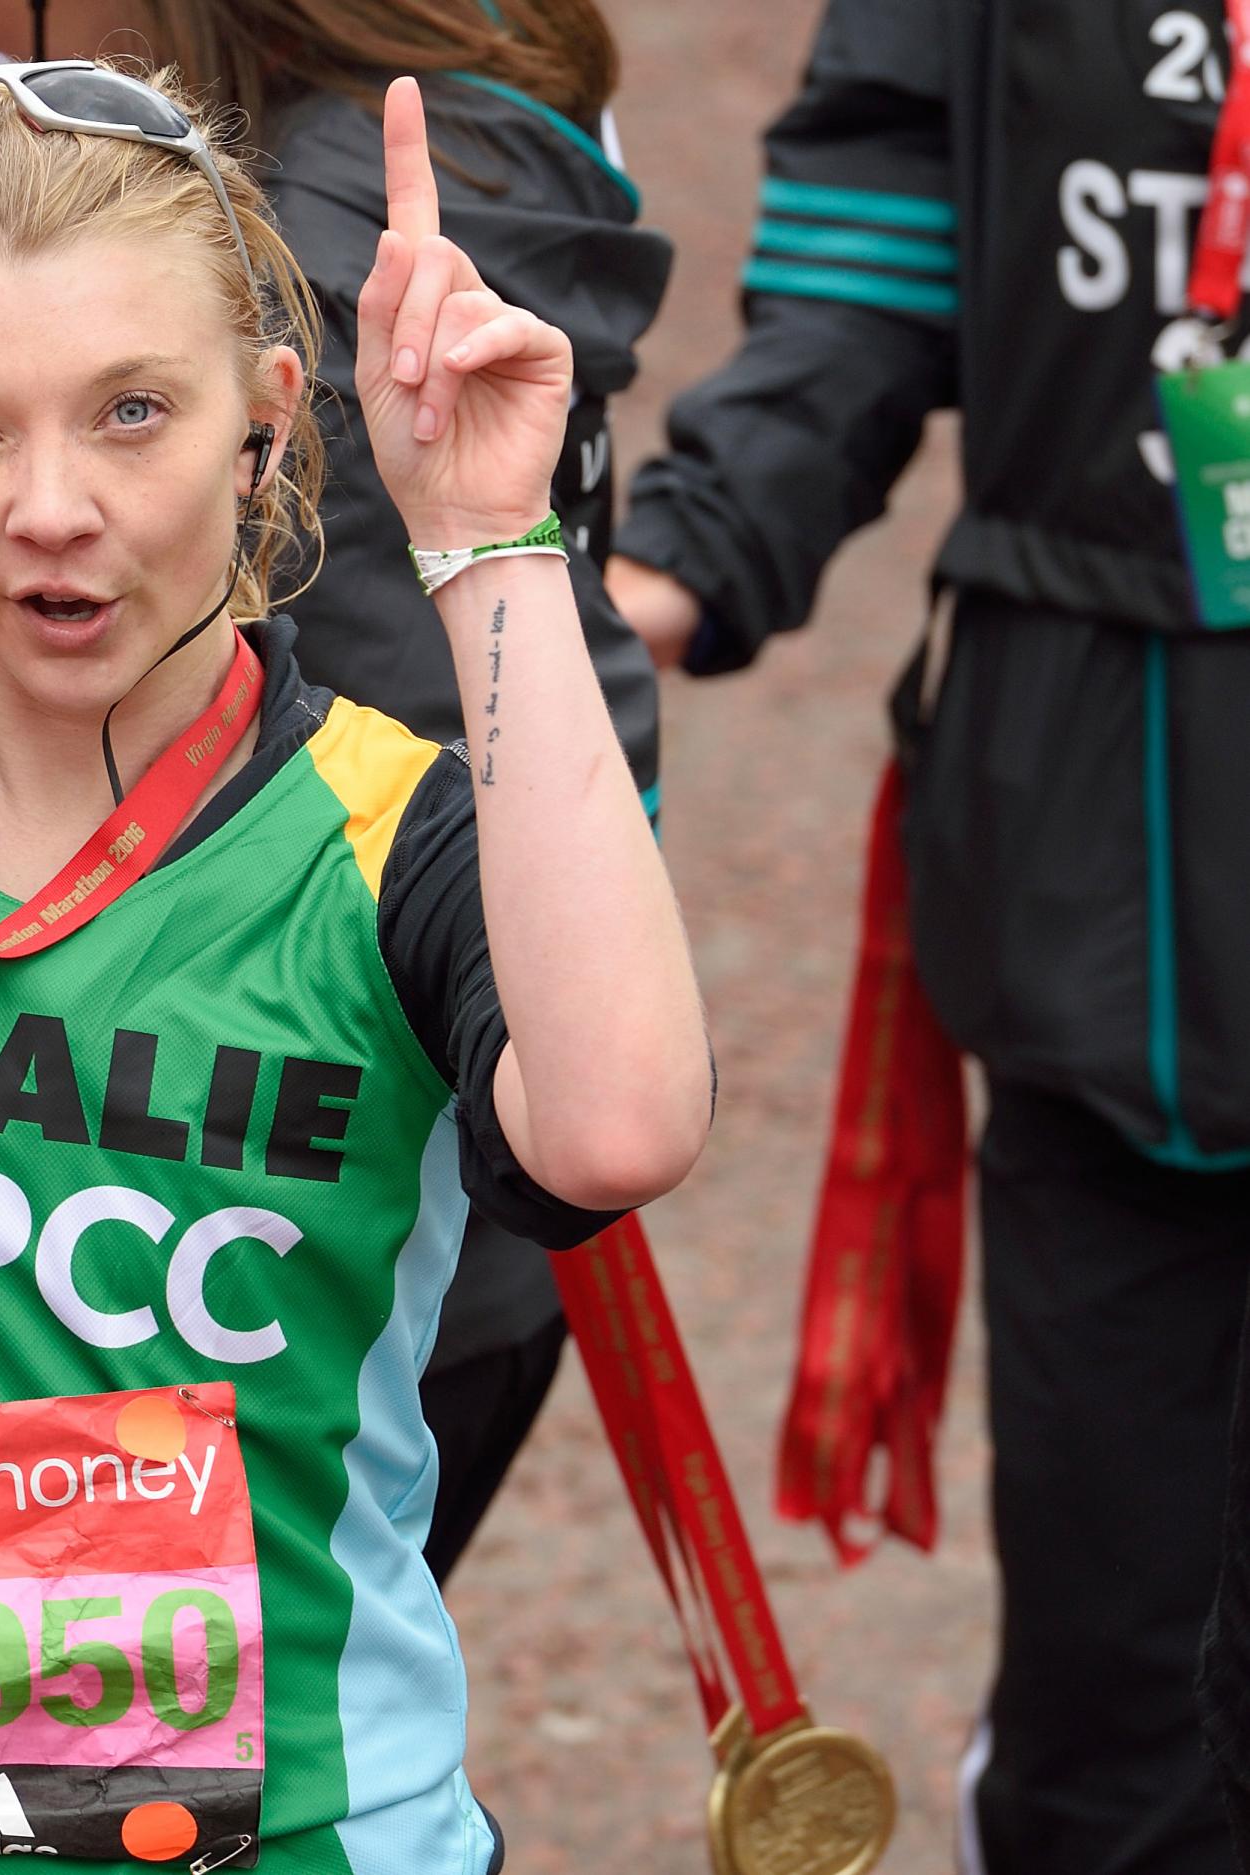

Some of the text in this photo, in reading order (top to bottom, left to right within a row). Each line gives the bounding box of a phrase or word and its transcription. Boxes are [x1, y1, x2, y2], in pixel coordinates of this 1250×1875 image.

[485, 691, 498, 717] the
[185, 725, 222, 768] Virgin
[480, 754, 494, 787] Fear
[39, 859, 116, 926] Marathon
[107, 820, 146, 865] 2016
[235, 1731, 255, 1763] 5
